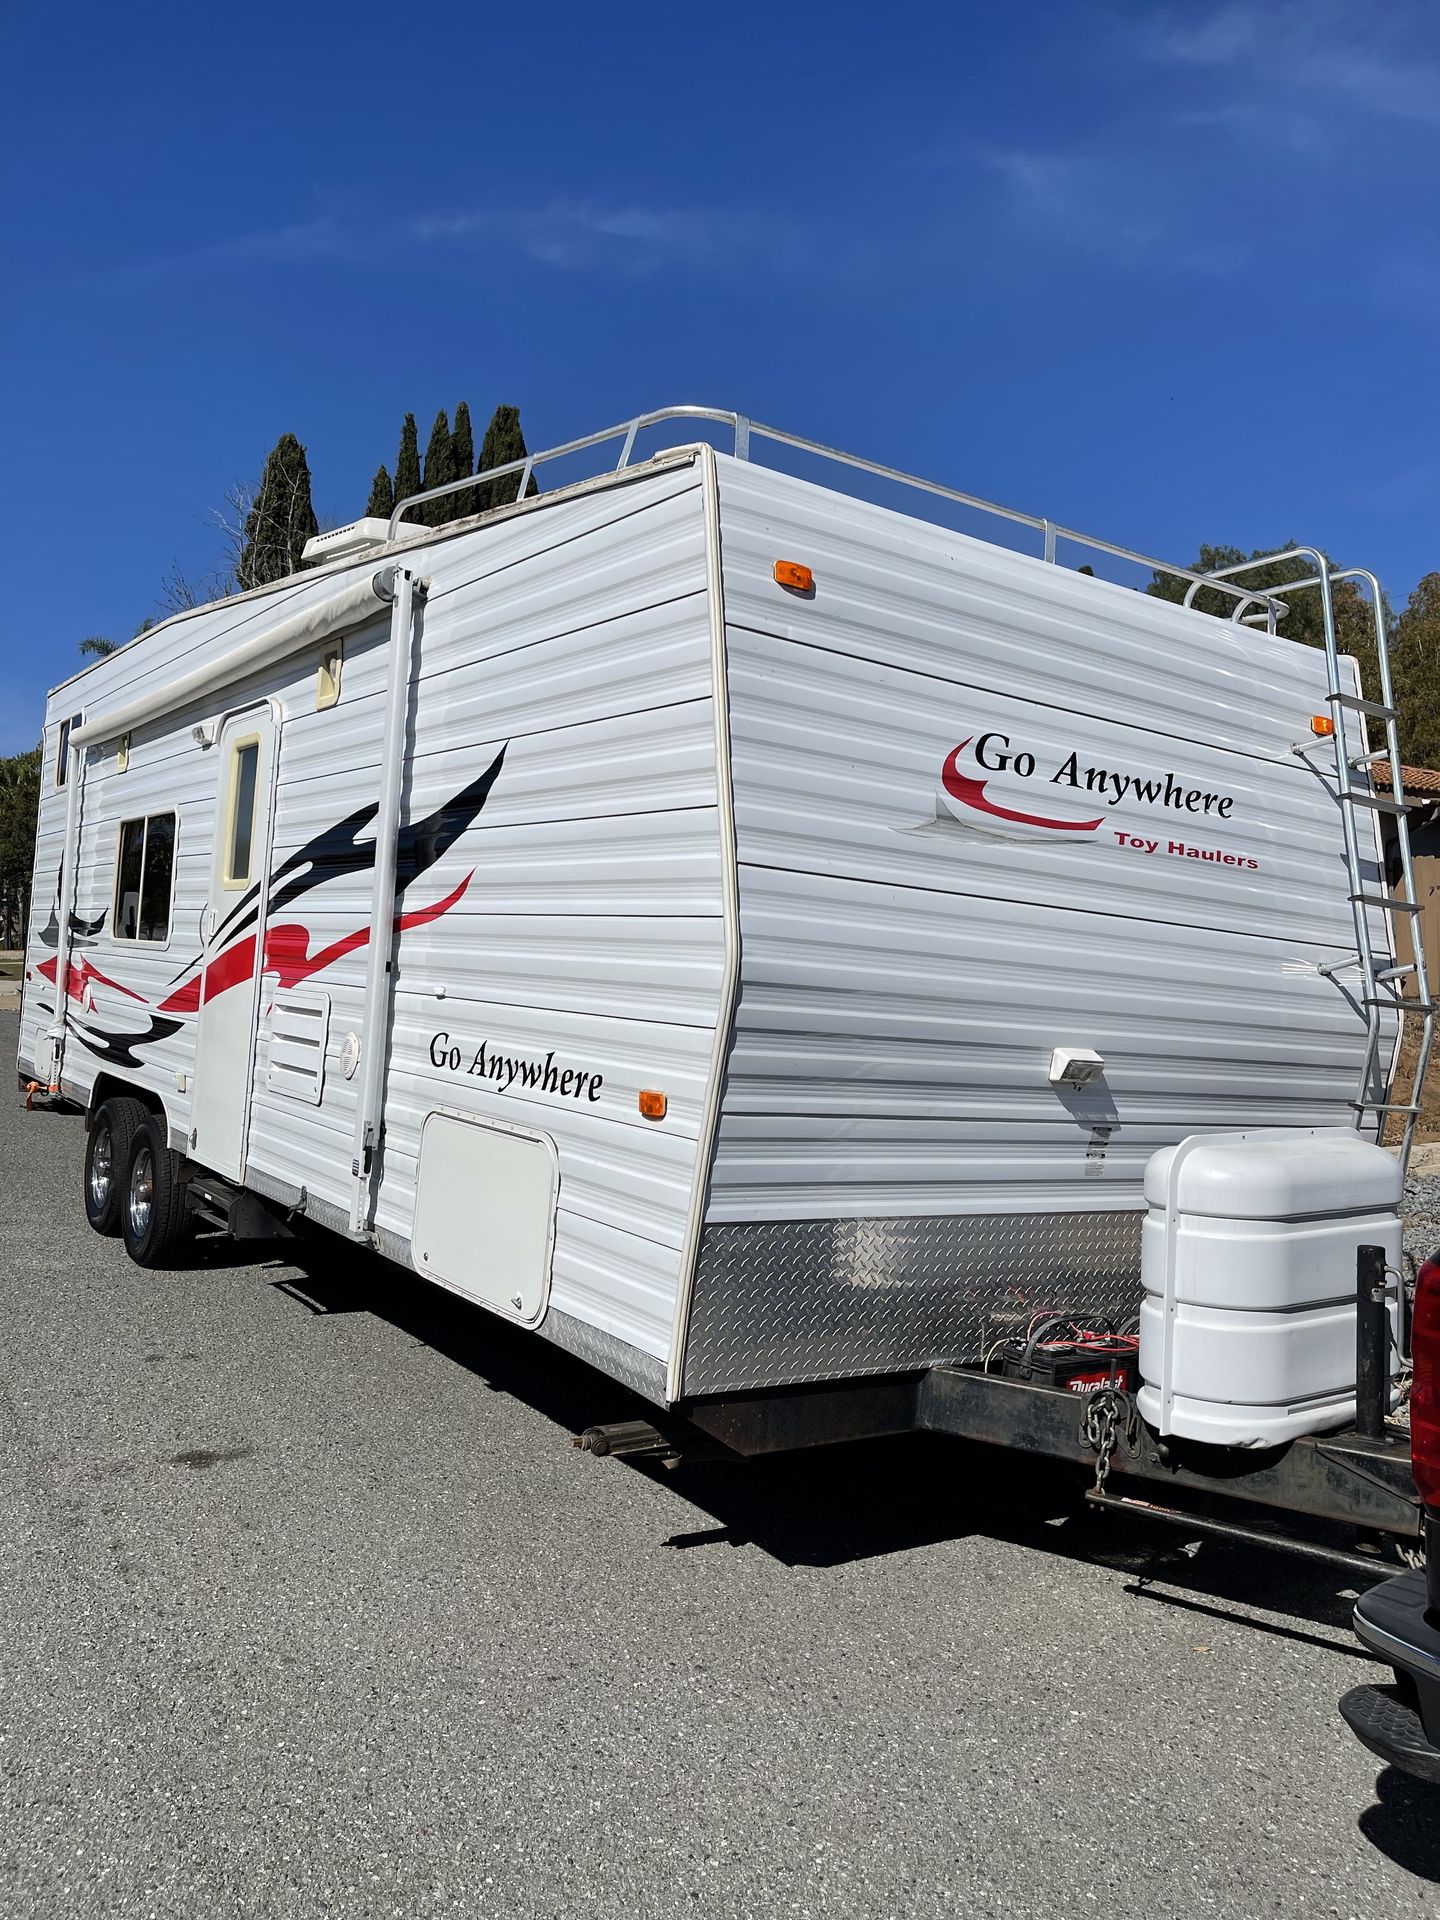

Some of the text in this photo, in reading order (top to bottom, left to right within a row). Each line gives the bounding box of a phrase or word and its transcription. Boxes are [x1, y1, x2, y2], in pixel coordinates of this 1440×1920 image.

[974, 732, 1235, 820] Go Anywhere
[1113, 831, 1260, 870] Toy Haulers
[429, 1032, 604, 1102] Go Anywhere
